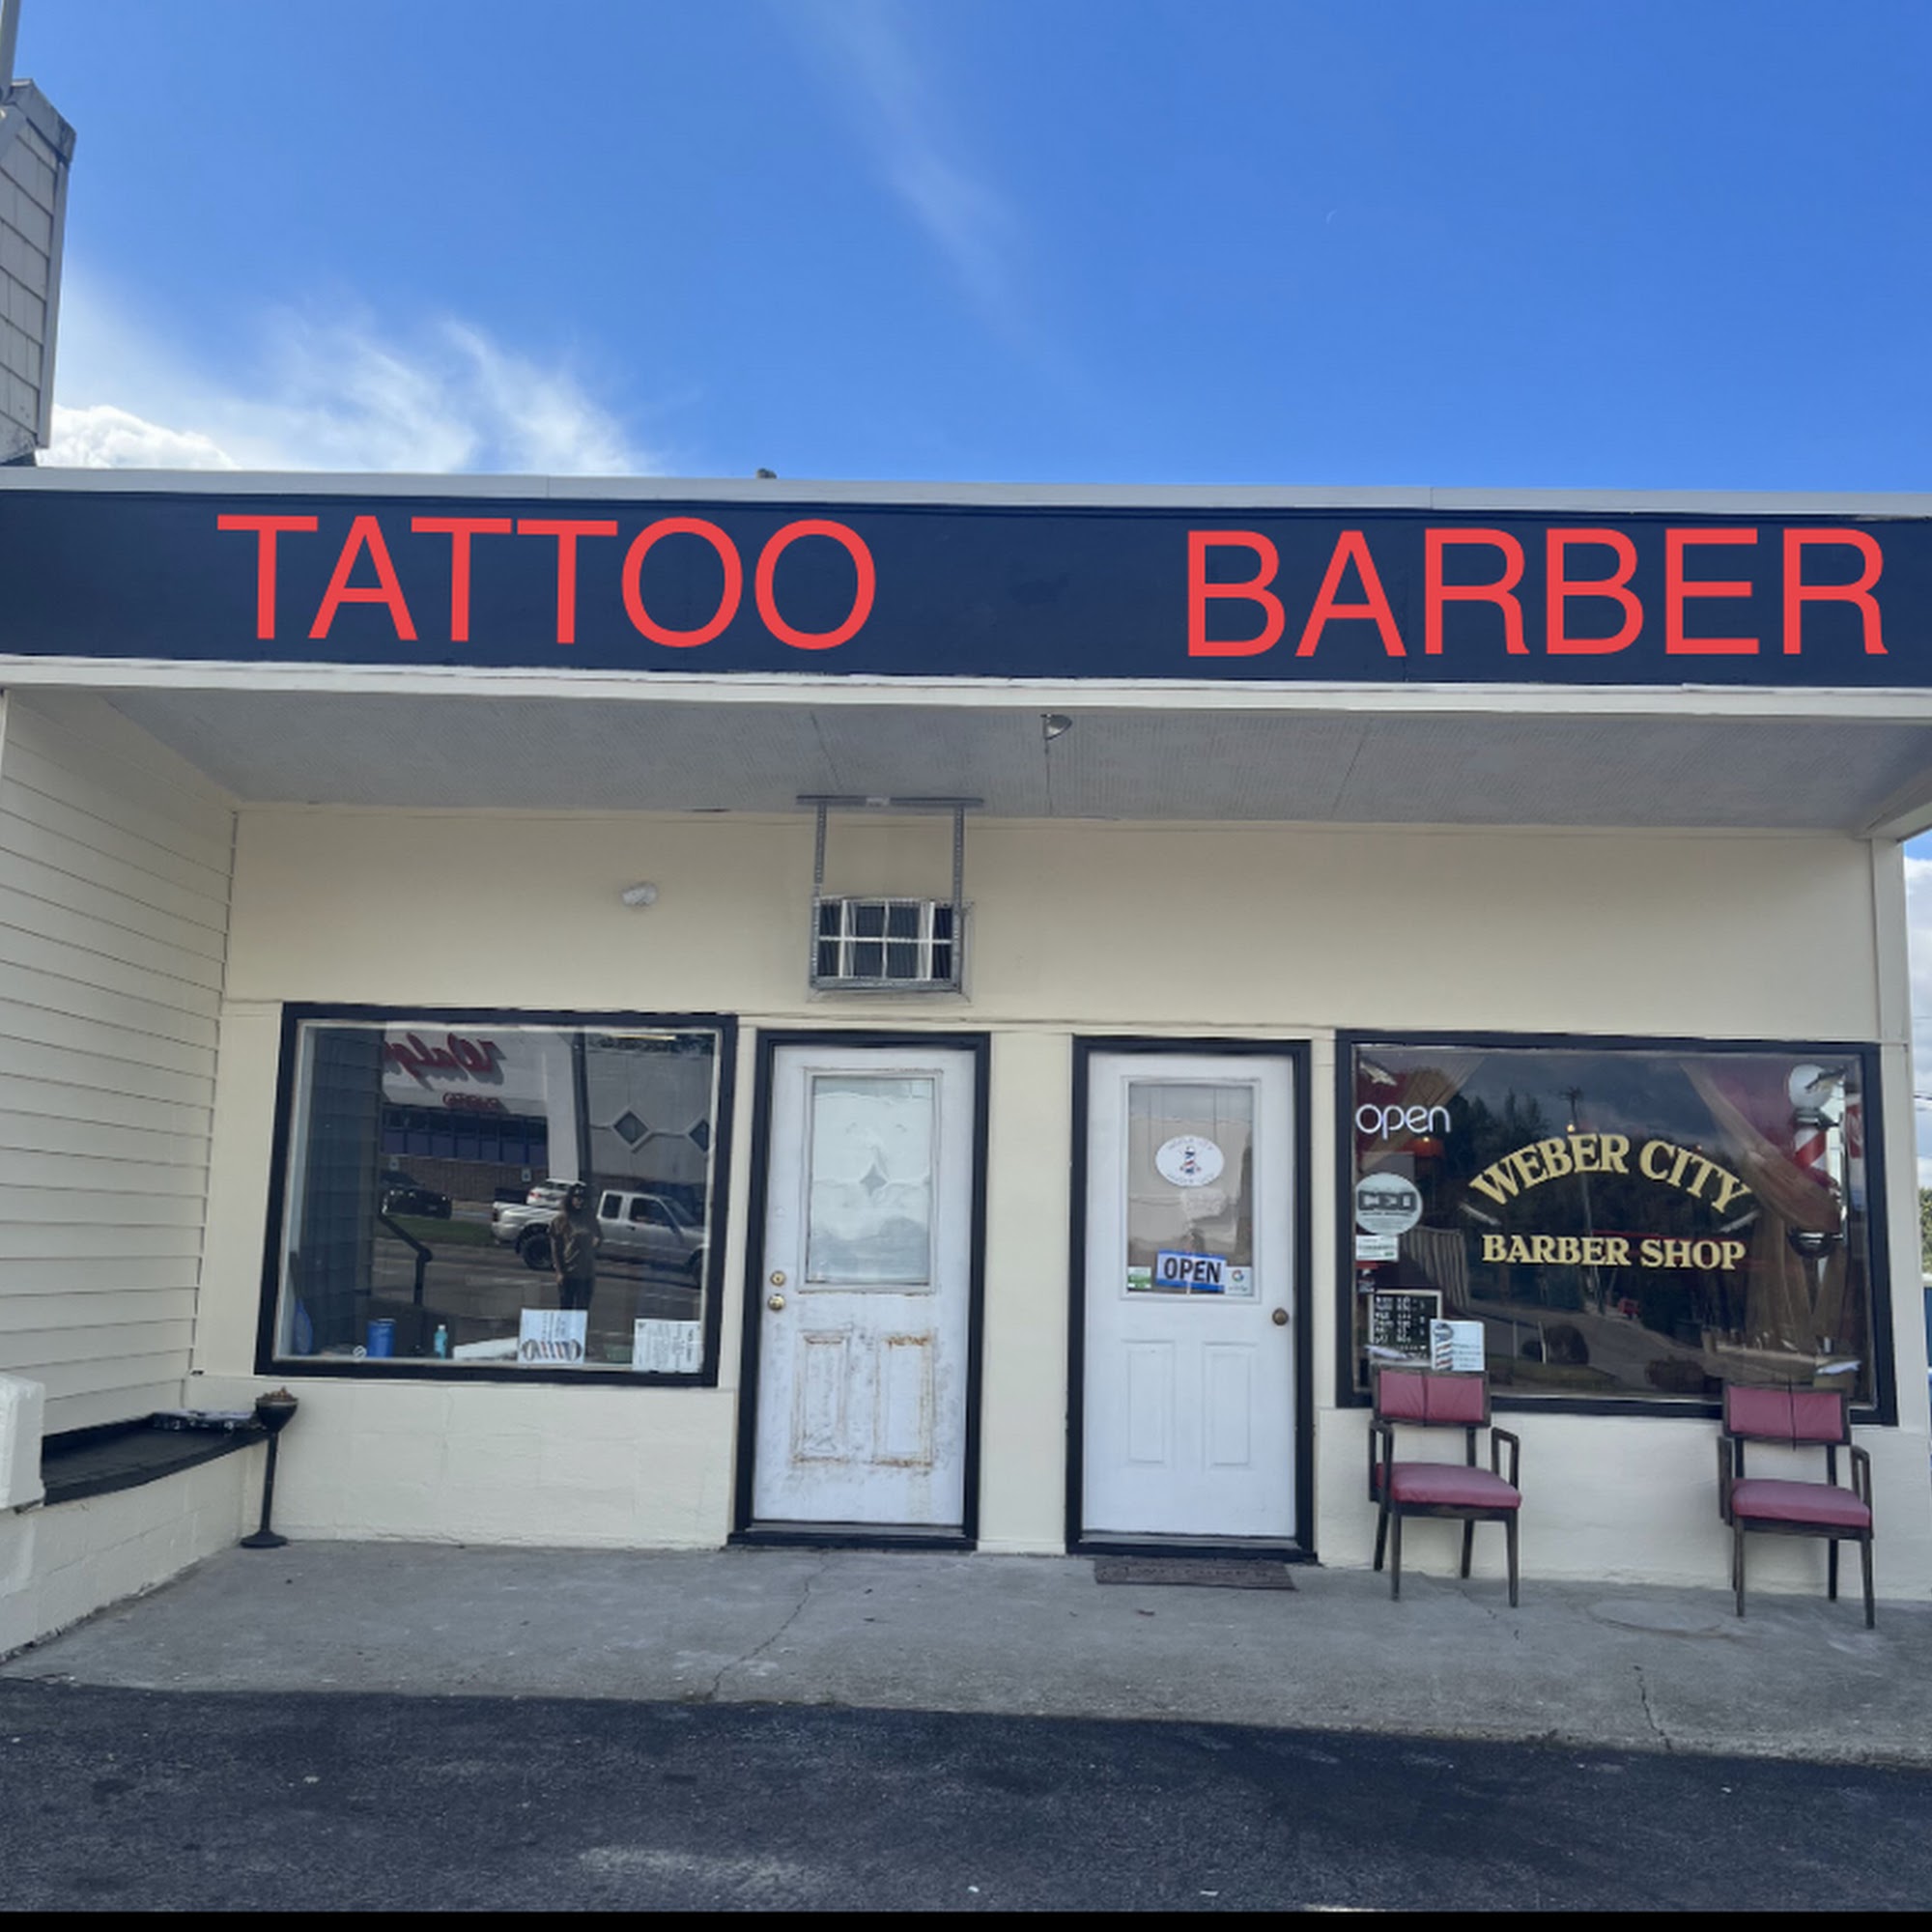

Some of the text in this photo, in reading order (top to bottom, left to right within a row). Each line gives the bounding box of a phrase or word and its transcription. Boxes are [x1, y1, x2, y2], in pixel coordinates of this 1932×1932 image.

[217, 514, 1889, 657] TATTOO BARBER
[1355, 1104, 1451, 1140] open
[1468, 1133, 1751, 1213] WEBER CITY
[1482, 1235, 1746, 1269] BARBER SHOP
[1164, 1257, 1221, 1284] OPEN
